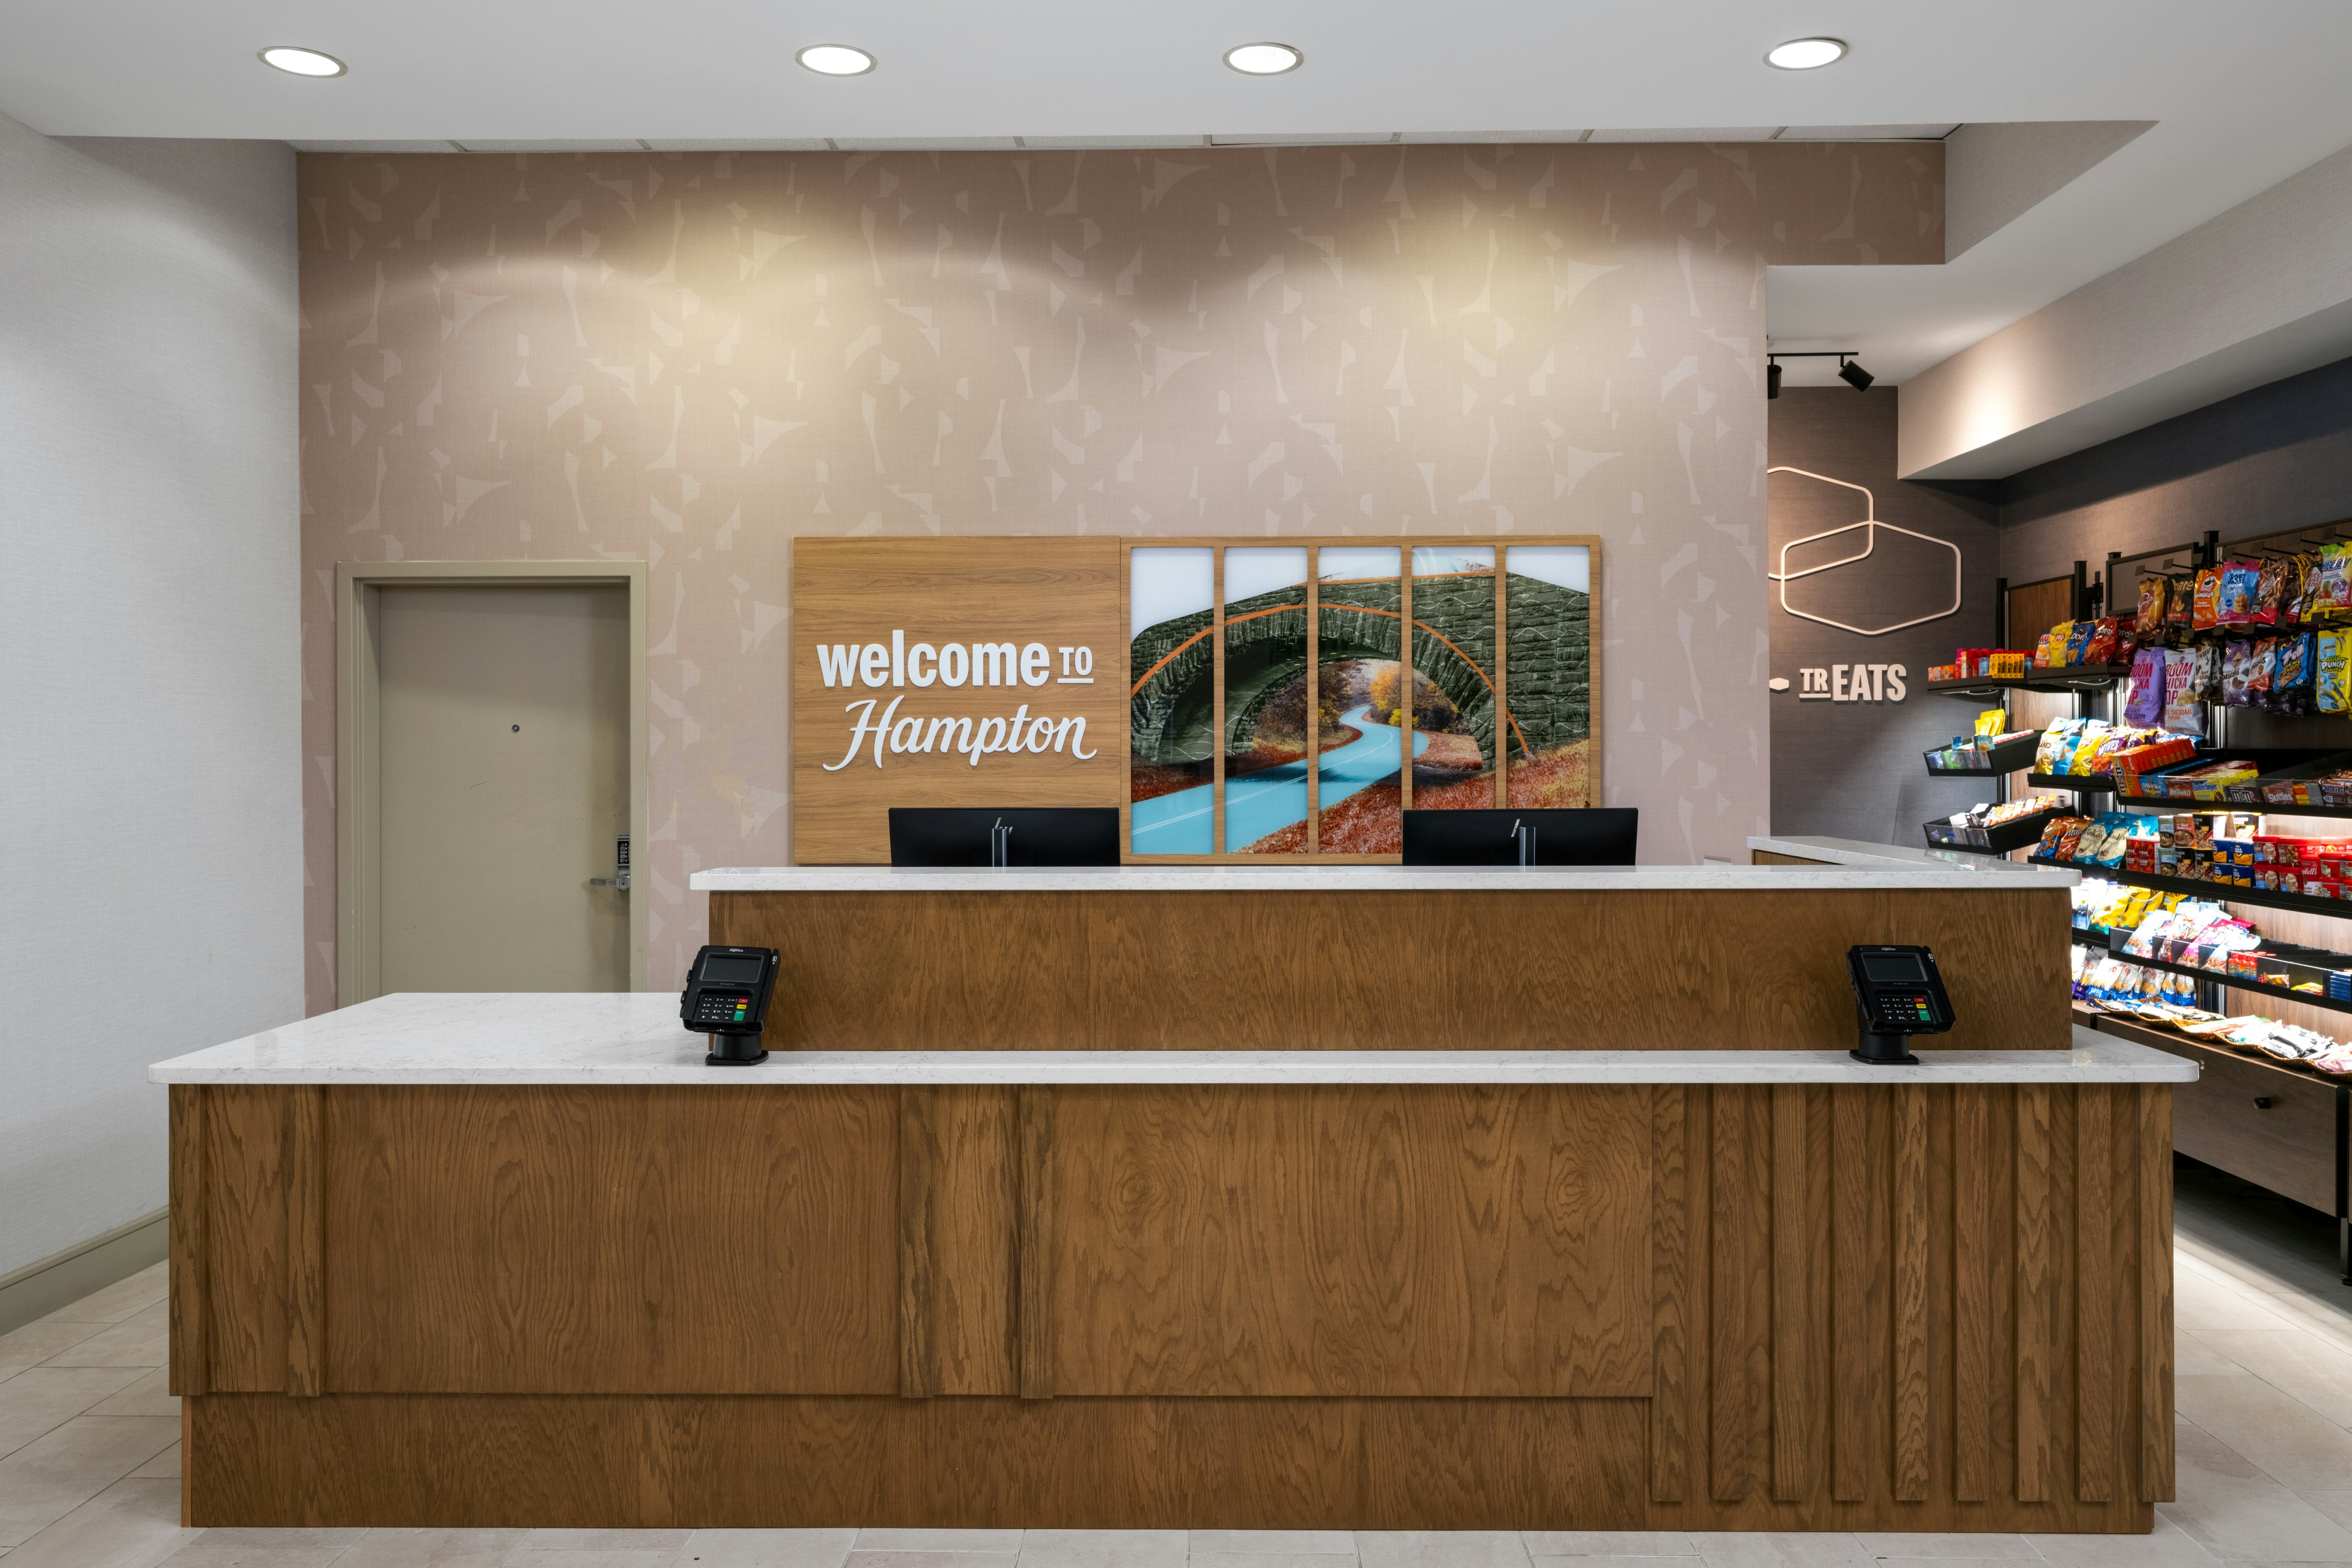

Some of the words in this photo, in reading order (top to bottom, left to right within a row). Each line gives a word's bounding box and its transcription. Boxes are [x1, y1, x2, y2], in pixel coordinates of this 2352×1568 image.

[816, 630, 1050, 687] welcome
[1058, 647, 1093, 676] TO
[2321, 661, 2346, 670] PUNCH
[1800, 664, 1907, 701] TREATS
[2166, 677, 2187, 689] HICKA
[823, 695, 1097, 771] Hampton
[2192, 783, 2217, 791] Butterfinger
[2323, 785, 2344, 794] SNICKERS
[2268, 792, 2293, 803] Skittles
